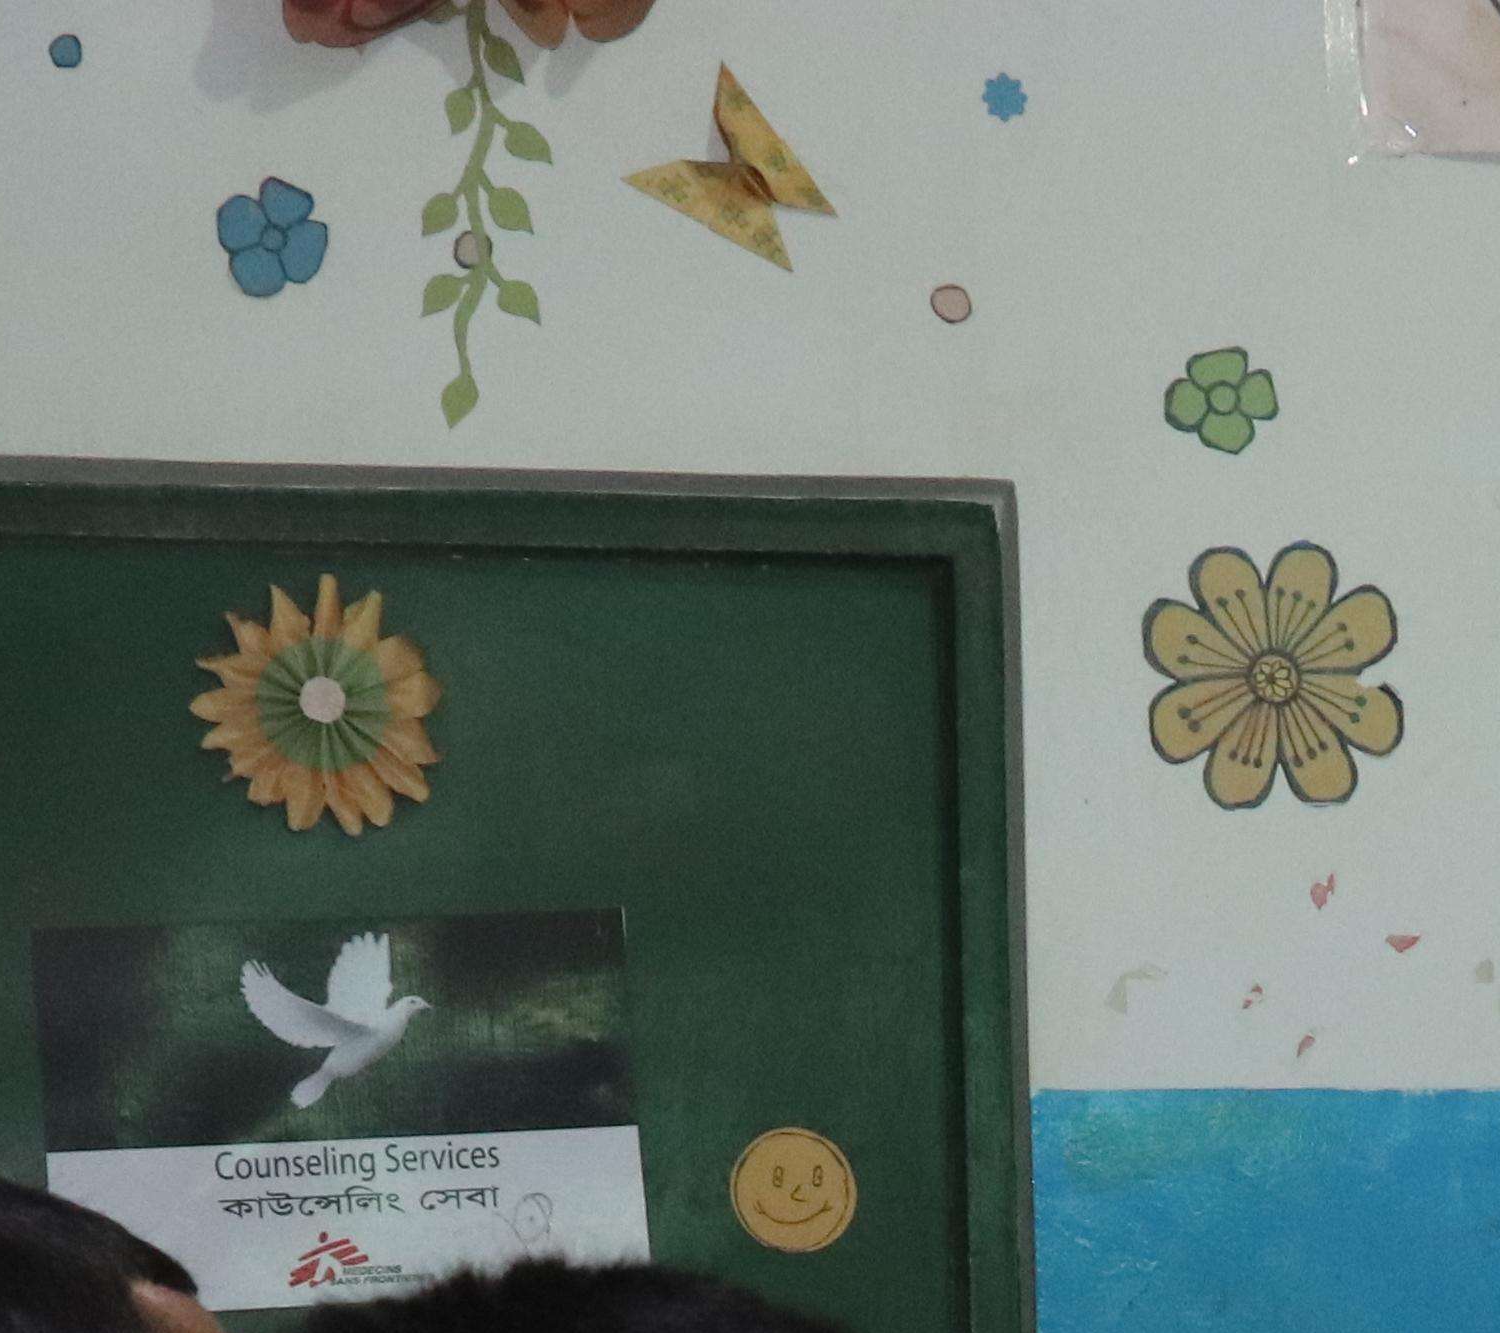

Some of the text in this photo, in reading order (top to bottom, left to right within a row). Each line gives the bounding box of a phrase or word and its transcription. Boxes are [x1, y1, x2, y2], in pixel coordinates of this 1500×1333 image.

[215, 1141, 500, 1182] Counseling Services
[420, 1186, 499, 1211] সেবা
